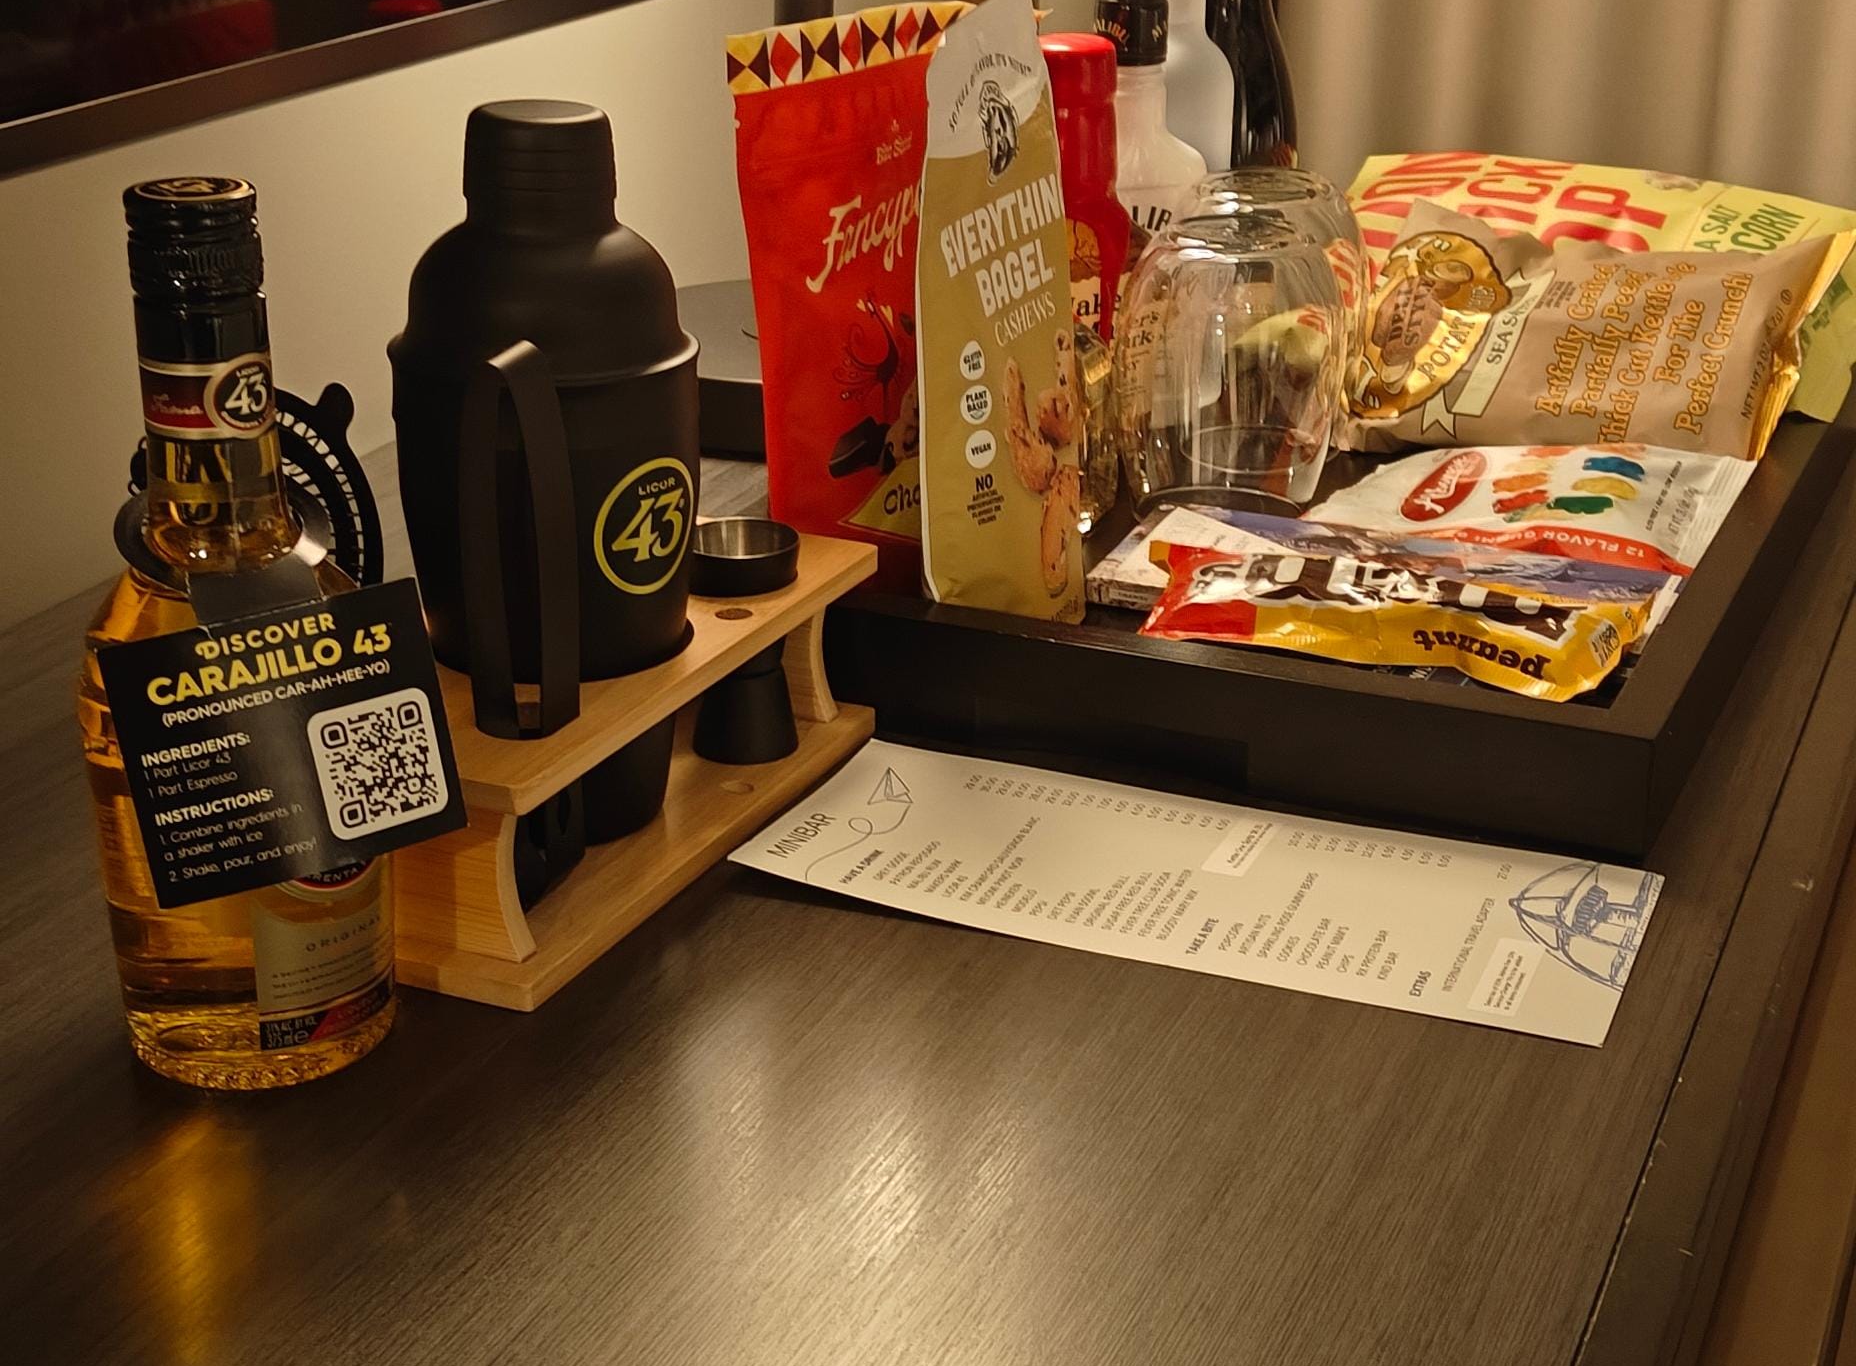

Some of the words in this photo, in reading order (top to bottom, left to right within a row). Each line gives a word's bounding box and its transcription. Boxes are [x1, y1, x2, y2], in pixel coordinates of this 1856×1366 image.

[941, 173, 1060, 278] EVERYTHIN
[1540, 185, 1667, 253] OP
[1701, 203, 1742, 235] SALT
[1730, 203, 1805, 252] CORN
[975, 238, 1054, 318] BAGEL
[994, 291, 1056, 347] CASHEWS
[1630, 277, 1677, 347] Kettle
[1666, 299, 1706, 342] The
[1486, 330, 1514, 366] SEA
[1617, 348, 1654, 386] Cut
[1653, 343, 1690, 384] For
[1536, 325, 1594, 417] Artfully
[1569, 324, 1633, 418] Partially
[224, 372, 267, 415] 43
[965, 390, 988, 404] PLANT
[966, 400, 989, 413] BASED
[1674, 351, 1726, 435] Perfect
[970, 442, 992, 456] VEGAN
[638, 476, 676, 496] LICOR
[975, 473, 994, 493] NO
[611, 487, 684, 563] 43
[1541, 529, 1620, 553] FLAVOR
[1625, 545, 1646, 559] 12
[194, 611, 337, 661] DISCOVER
[1412, 629, 1550, 681] peanut
[147, 637, 343, 707] CARAJILLO
[352, 622, 392, 657] 43
[161, 690, 275, 728] (PRONOUNCED
[274, 658, 392, 701] CAR-AH-HEE-YO)
[140, 731, 252, 769] INGREDIENTS:
[153, 764, 180, 779] Part
[183, 756, 211, 773] Licor
[215, 752, 232, 765] 43
[157, 782, 184, 797] Part
[186, 769, 239, 793] Espresso
[154, 788, 275, 827] INSTRUCTIONS:
[170, 820, 224, 844] Combine
[226, 805, 289, 833] ingredients
[290, 802, 304, 815] in
[163, 851, 174, 863] a
[177, 840, 215, 859] shaker
[217, 833, 244, 850] with
[246, 829, 264, 844] ice
[223, 854, 255, 871] pour,
[256, 845, 282, 863] and
[283, 836, 318, 856] enjoy!
[766, 811, 837, 859] MINIBAR
[1408, 970, 1432, 997] EXTRAS
